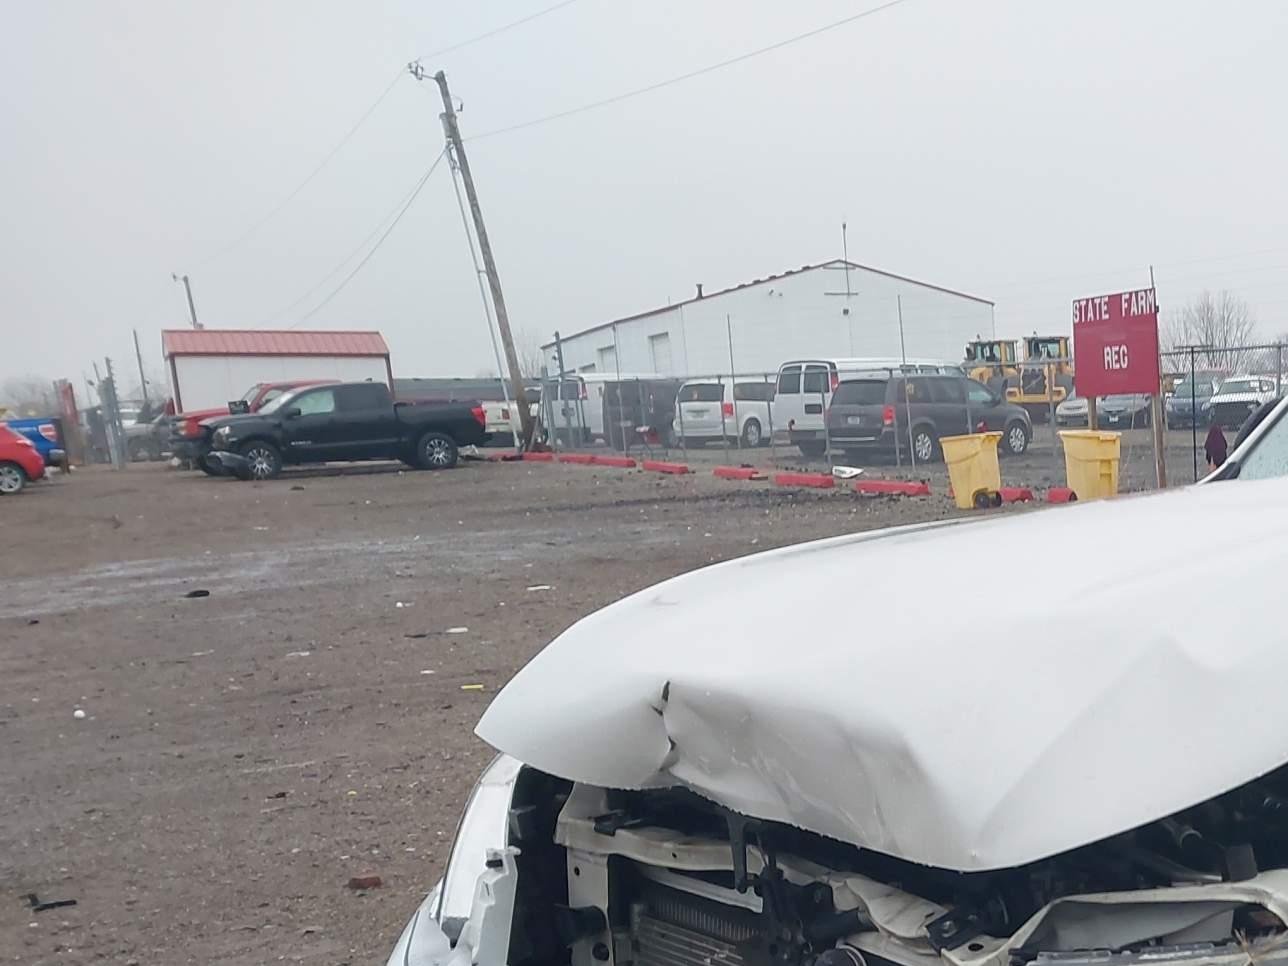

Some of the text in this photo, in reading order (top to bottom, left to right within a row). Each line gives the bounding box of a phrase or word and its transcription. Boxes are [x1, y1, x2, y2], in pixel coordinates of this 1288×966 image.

[1073, 289, 1155, 324] STATE FARM
[1103, 344, 1129, 370] REG
